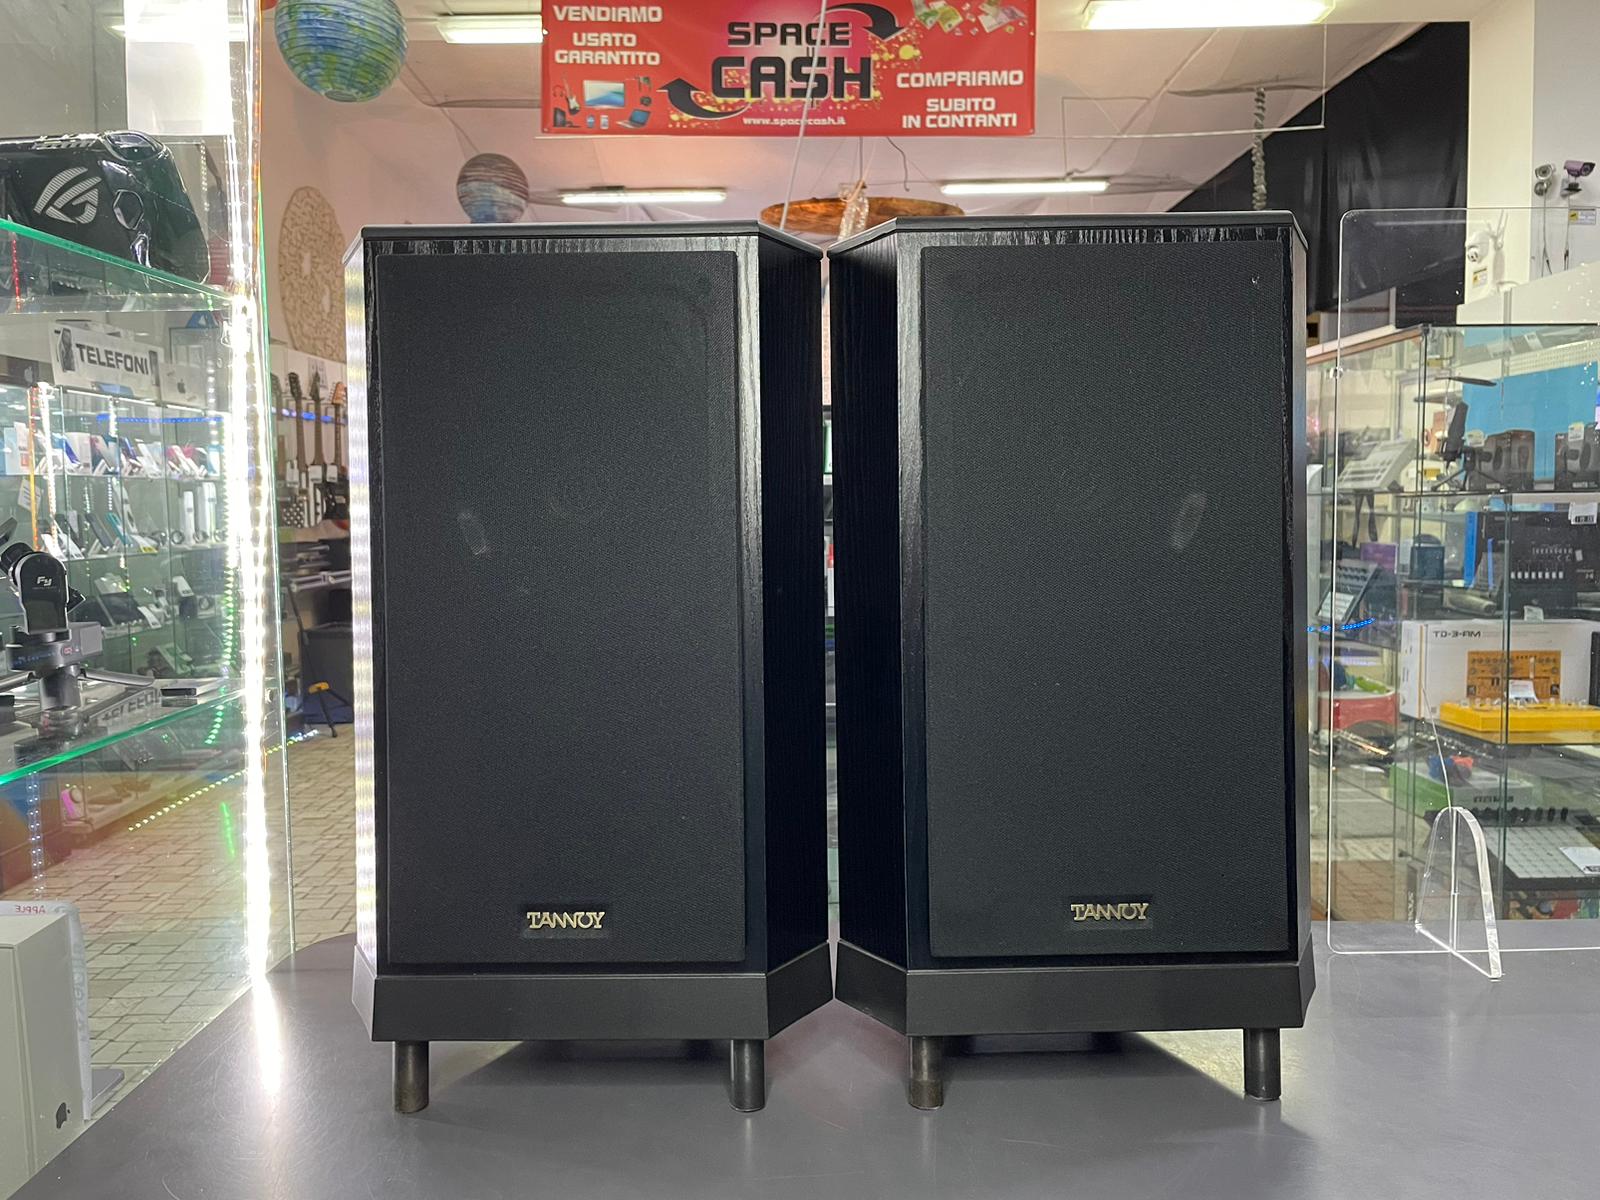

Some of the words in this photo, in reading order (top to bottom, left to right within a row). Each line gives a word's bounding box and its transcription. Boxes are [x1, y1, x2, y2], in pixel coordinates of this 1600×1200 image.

[552, 5, 663, 22] VENDIAMO
[572, 32, 637, 47] USATO
[728, 22, 850, 46] SPACE
[554, 50, 661, 65] GARANTITO
[712, 56, 873, 99] CASH
[896, 70, 1024, 88] COMPRIAMO
[926, 97, 996, 112] SUBITO
[743, 116, 846, 126] www.spaccash.it
[902, 115, 921, 128] IN
[925, 113, 1017, 128] CONTANTI
[75, 343, 149, 375] TELEFONI
[526, 911, 605, 929] TANNOY
[1070, 903, 1149, 921] TANNOY
